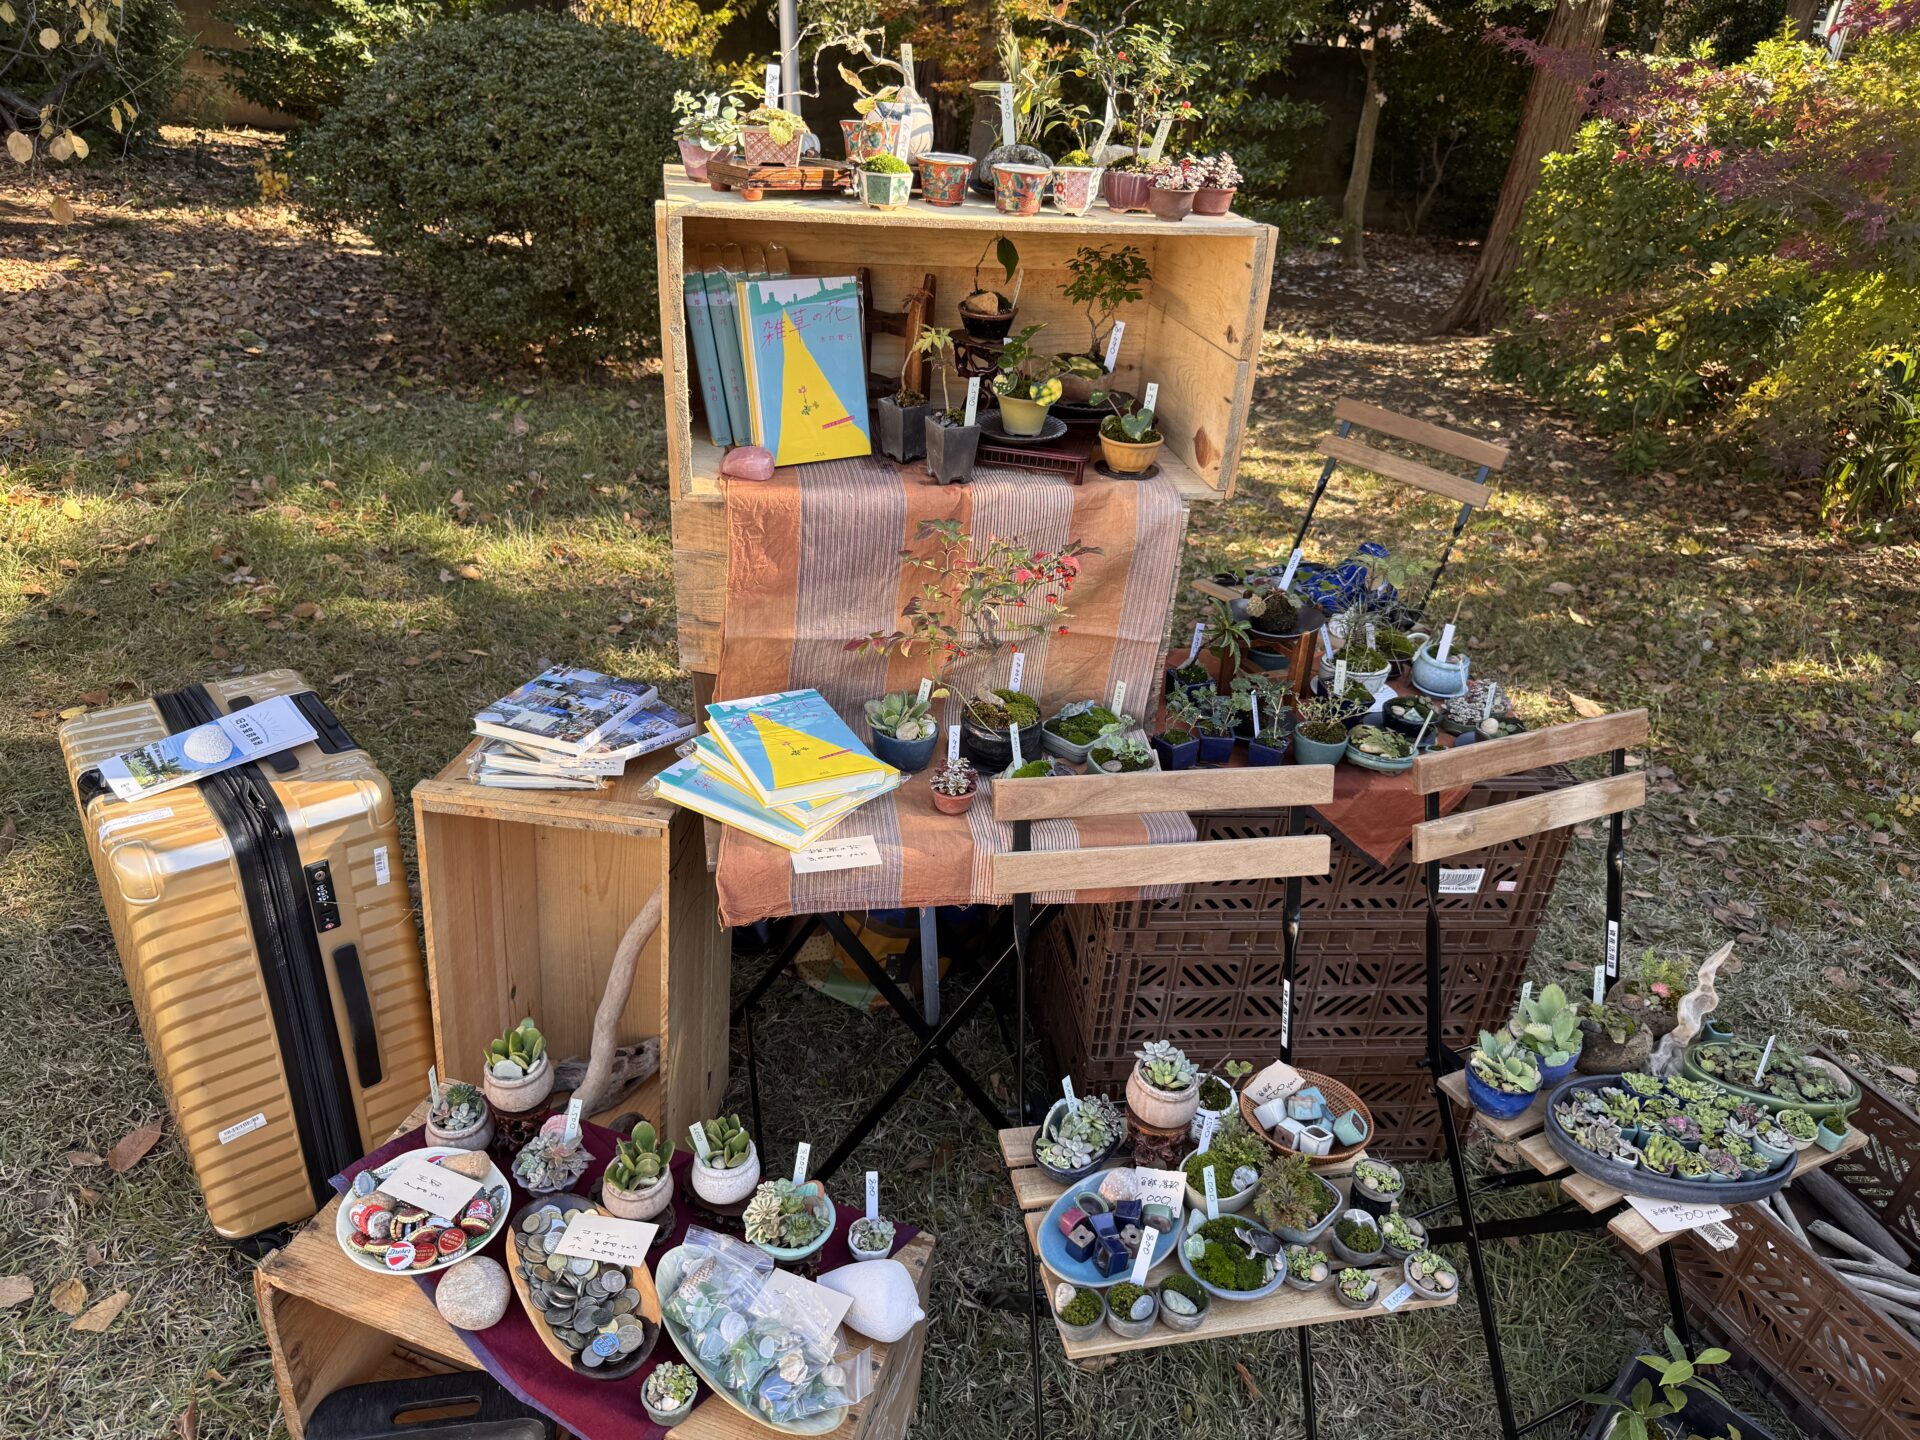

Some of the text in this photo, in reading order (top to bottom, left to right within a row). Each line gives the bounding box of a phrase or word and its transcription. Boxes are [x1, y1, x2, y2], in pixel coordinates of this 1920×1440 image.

[761, 299, 851, 349] 雑草の花
[1674, 1209, 1704, 1222] 500
